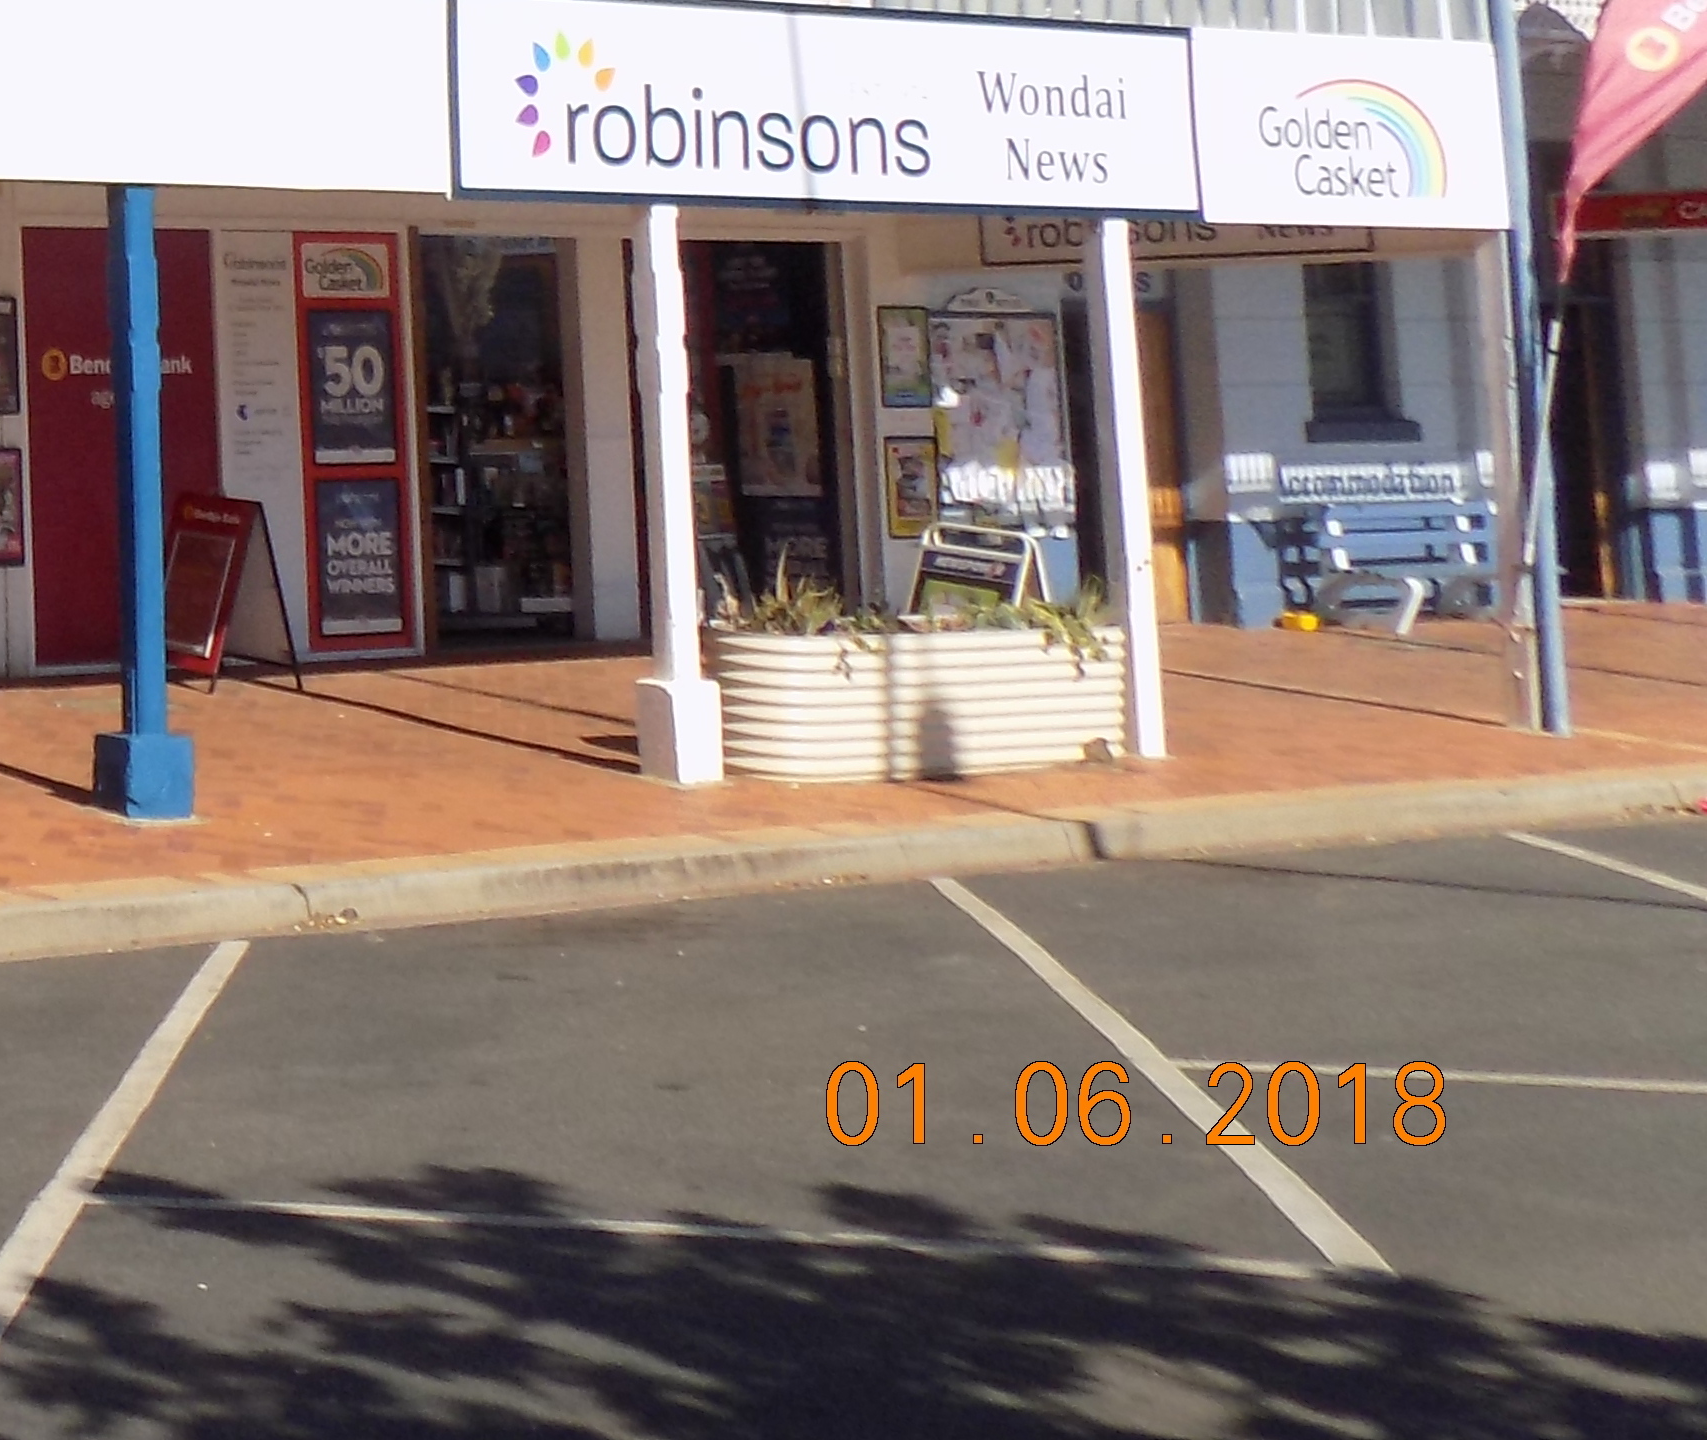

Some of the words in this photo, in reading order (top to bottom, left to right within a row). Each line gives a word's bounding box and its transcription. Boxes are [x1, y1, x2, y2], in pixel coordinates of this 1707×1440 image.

[976, 70, 1128, 120] Wondai
[565, 83, 931, 178] robinsons
[1258, 105, 1373, 150] Golden
[1004, 137, 1109, 184] News
[1294, 153, 1400, 198] Casket
[326, 531, 393, 557] MORE
